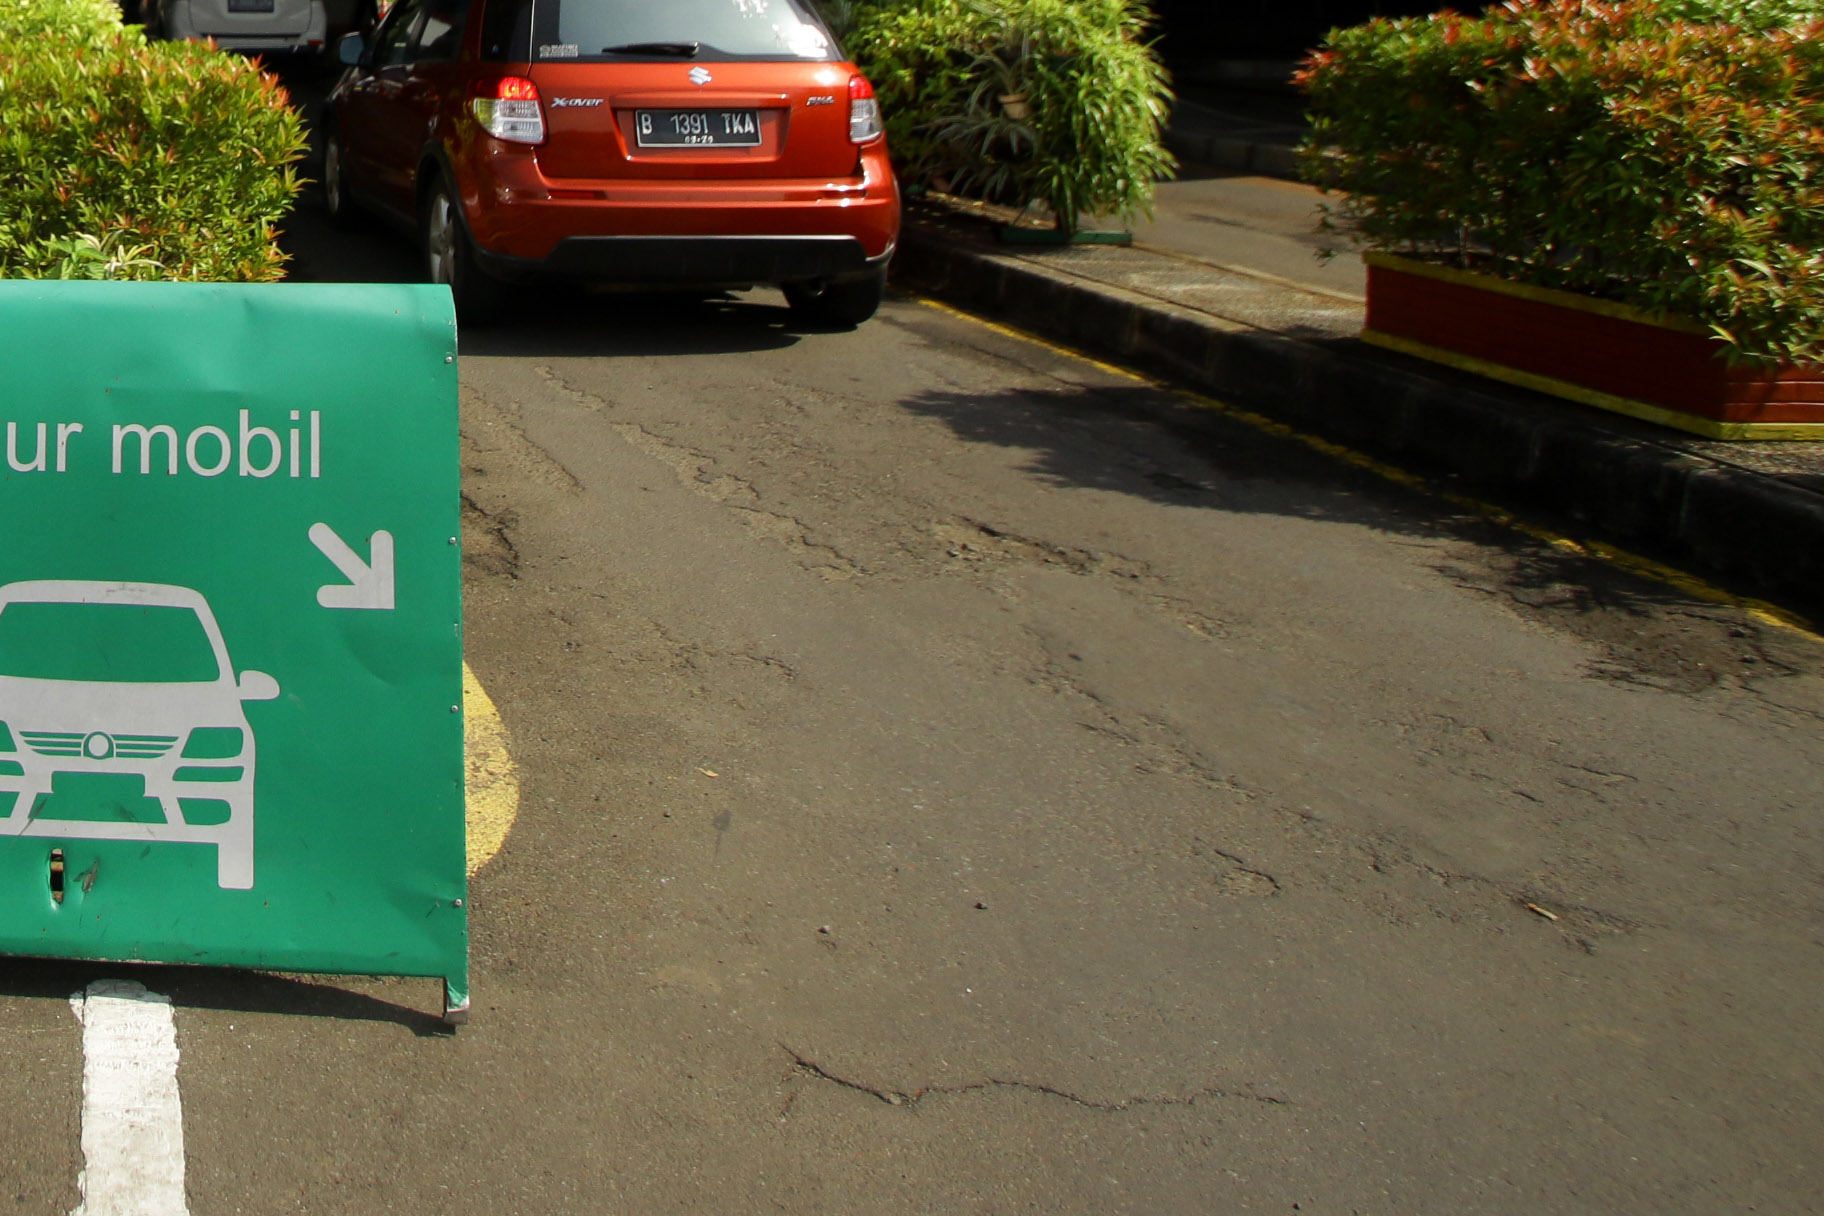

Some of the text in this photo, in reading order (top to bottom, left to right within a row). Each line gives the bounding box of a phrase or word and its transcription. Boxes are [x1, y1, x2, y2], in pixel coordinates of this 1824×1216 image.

[640, 112, 755, 135] B 1391 TKA
[111, 409, 321, 478] mobil
